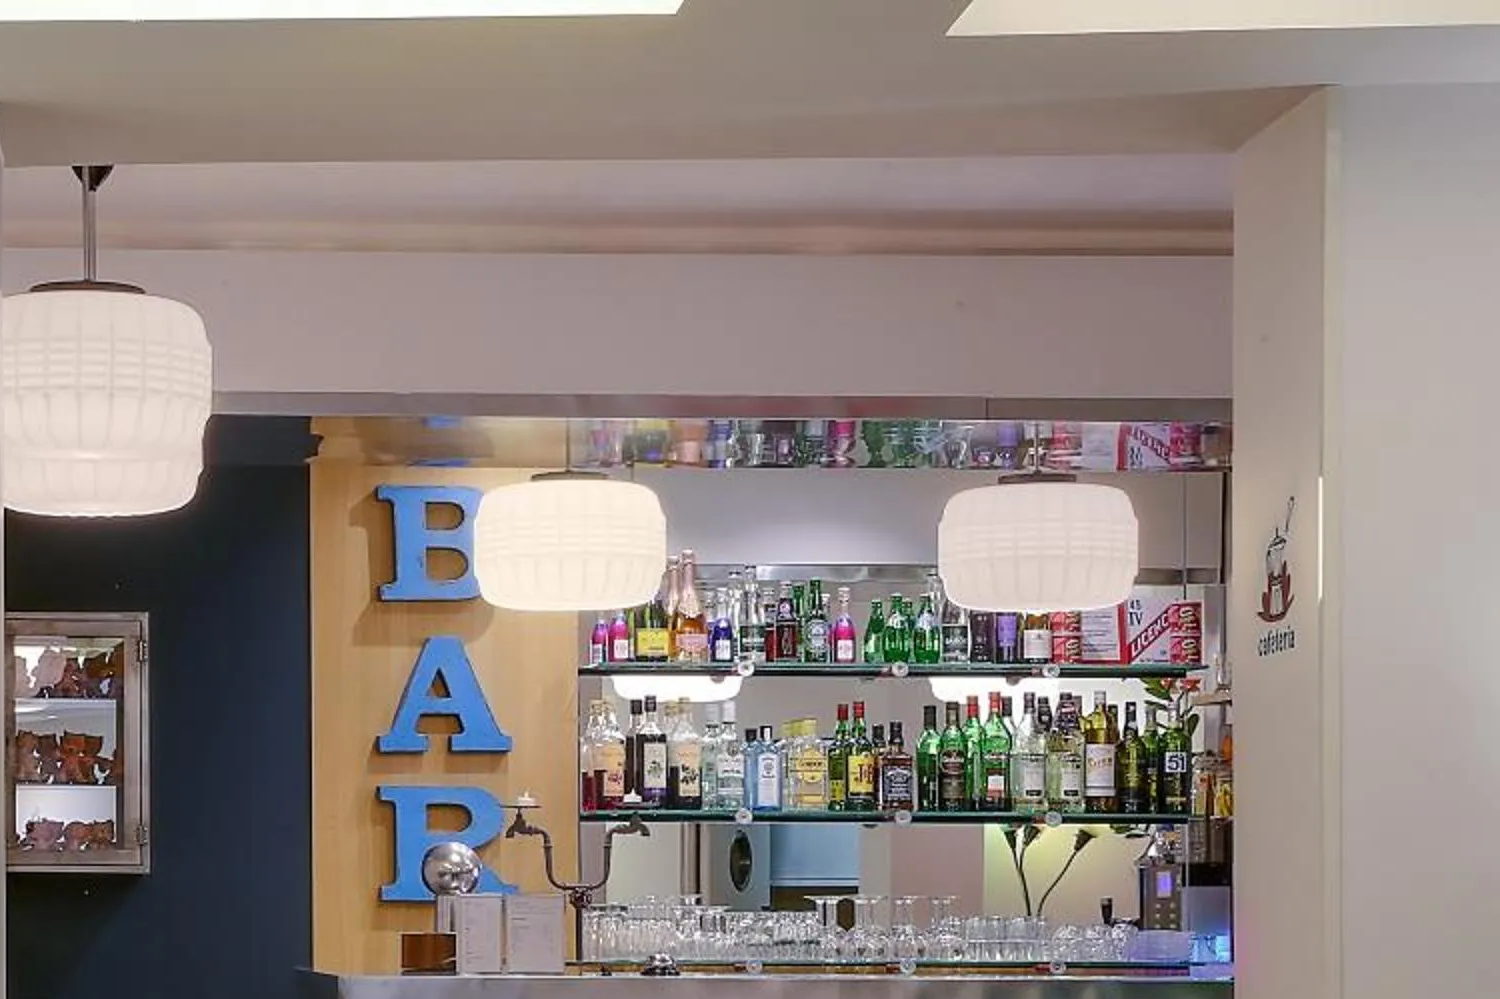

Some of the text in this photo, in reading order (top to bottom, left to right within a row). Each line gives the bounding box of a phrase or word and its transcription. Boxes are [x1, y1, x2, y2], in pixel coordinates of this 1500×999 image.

[1131, 613, 1169, 658] LICENC
[376, 484, 519, 902] BAR
[1167, 753, 1186, 771] 51
